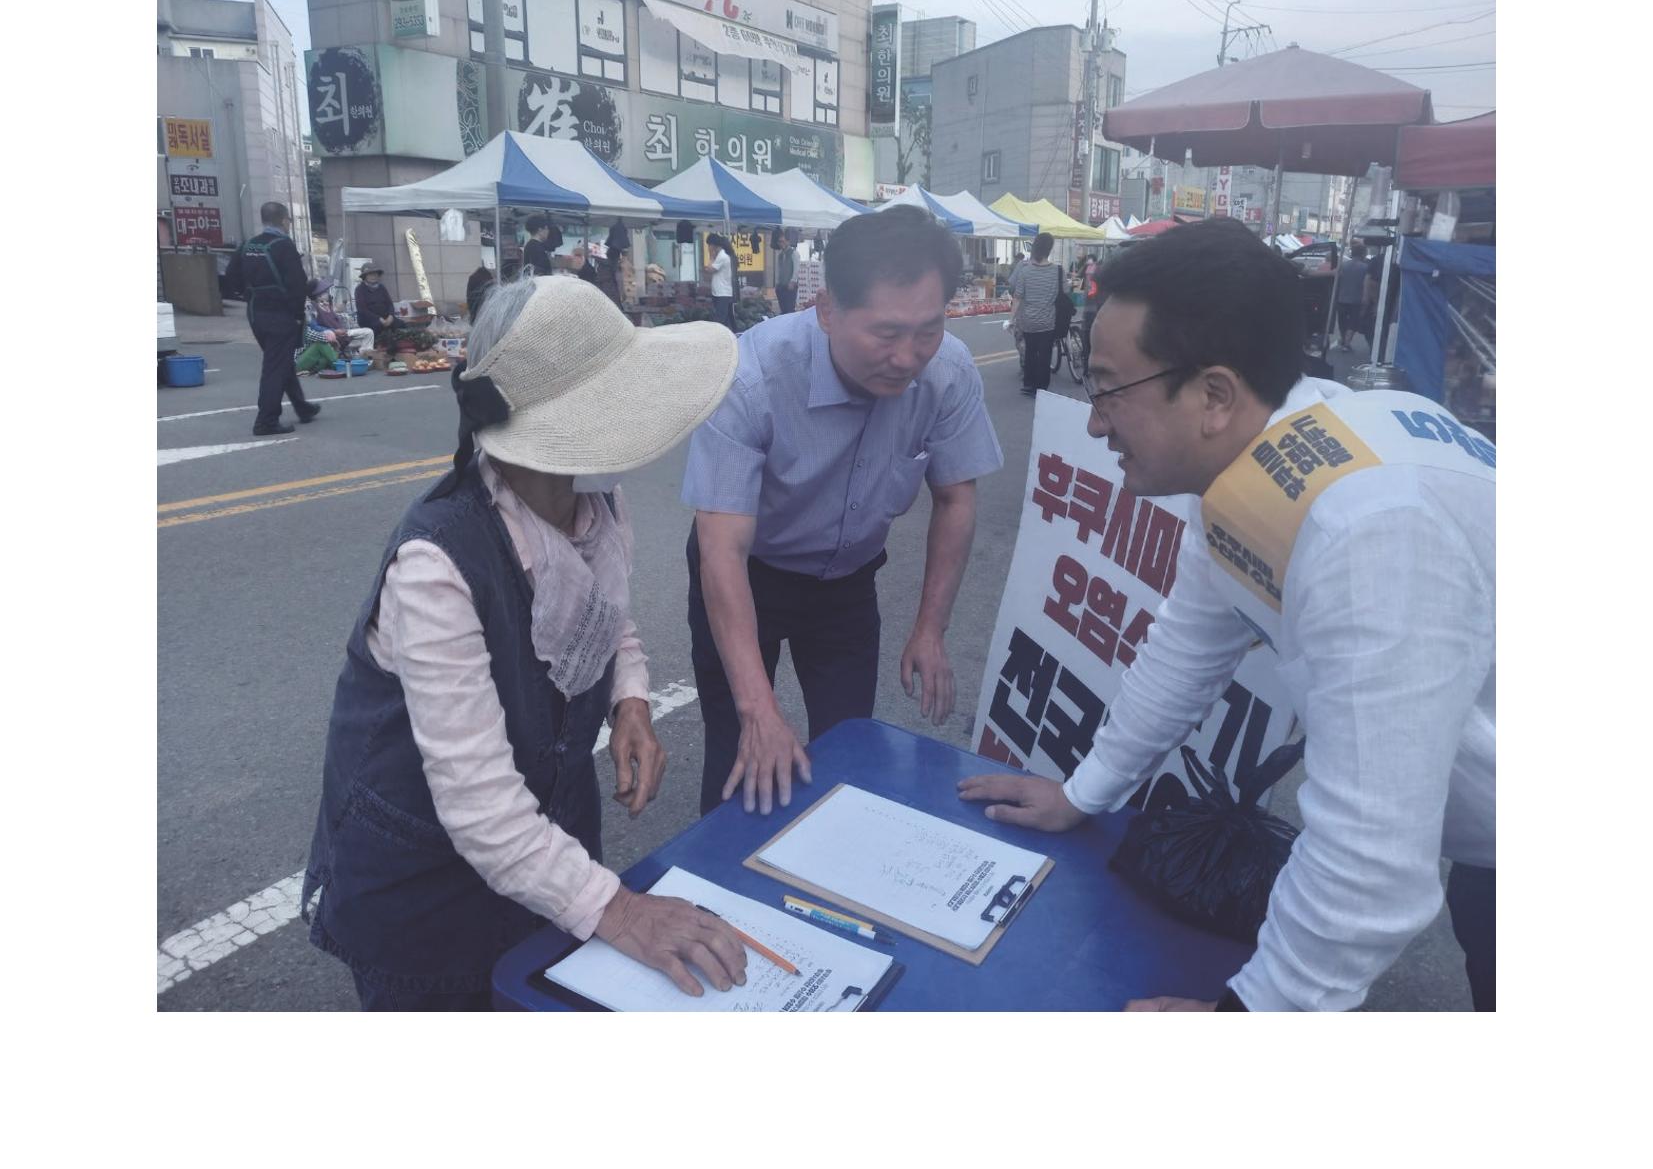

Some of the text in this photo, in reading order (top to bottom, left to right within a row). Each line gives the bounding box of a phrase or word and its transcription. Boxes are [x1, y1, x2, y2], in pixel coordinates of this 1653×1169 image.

[644, 114, 678, 171] 최
[1217, 166, 1229, 207] BYC
[1031, 452, 1187, 599] 후쿠시마
